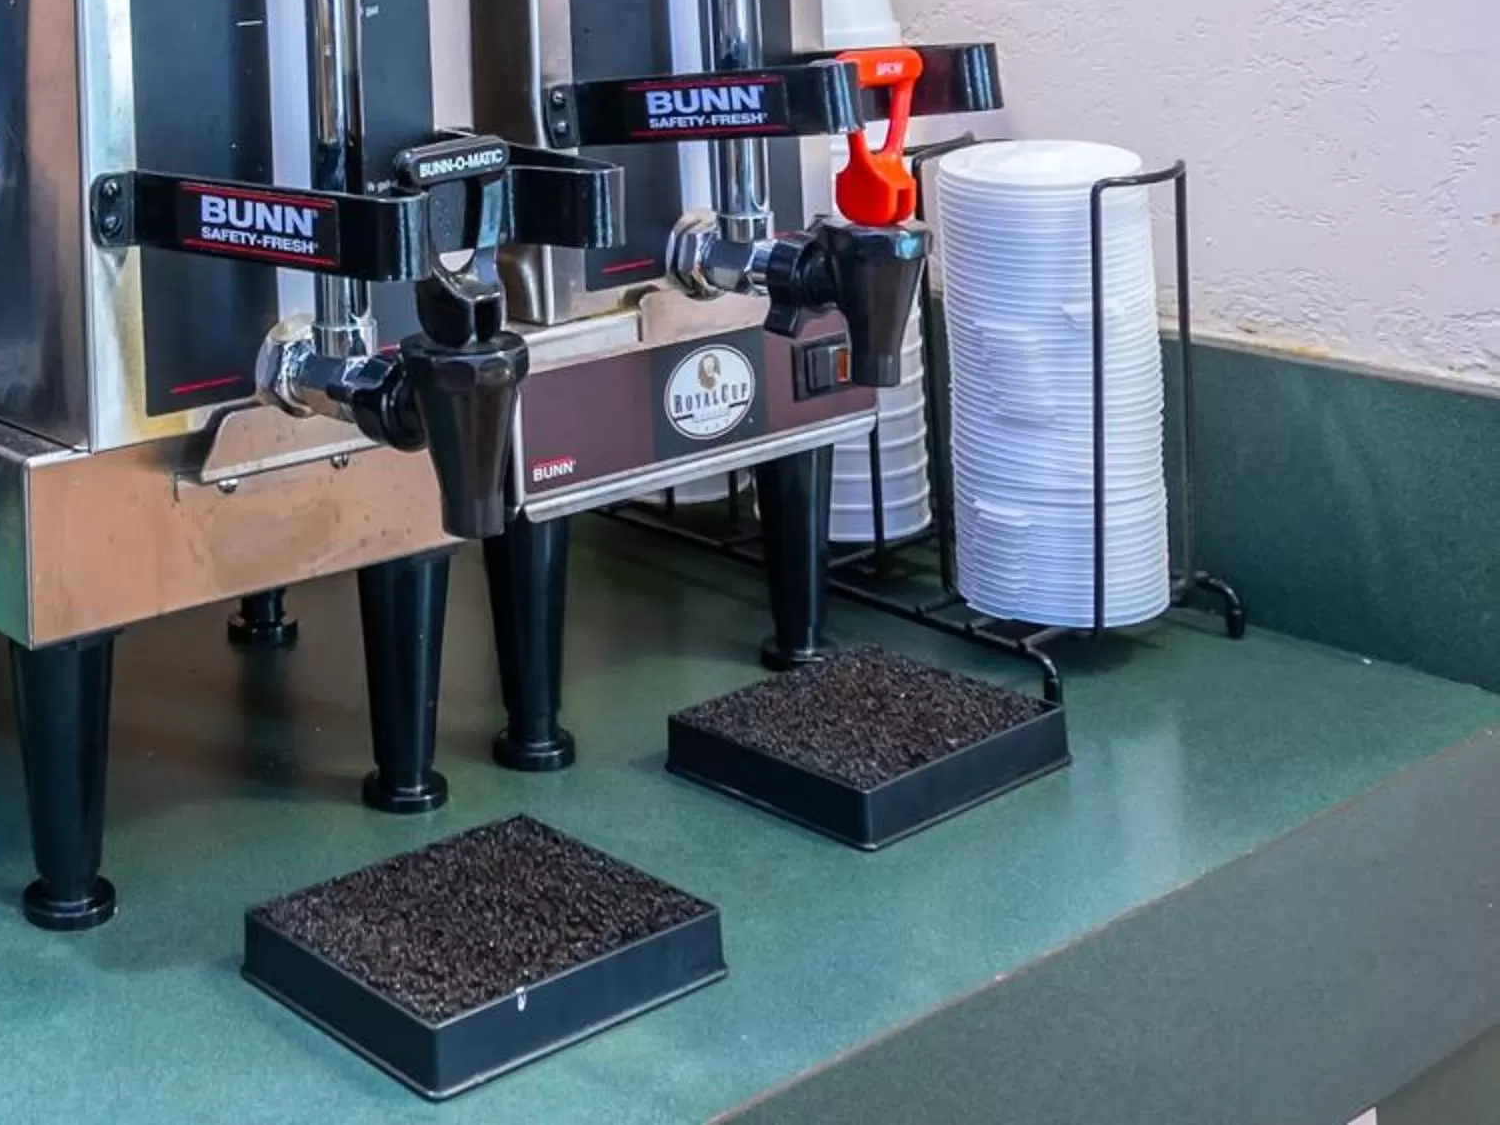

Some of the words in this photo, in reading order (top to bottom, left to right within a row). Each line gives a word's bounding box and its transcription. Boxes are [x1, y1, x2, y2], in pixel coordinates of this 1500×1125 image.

[645, 85, 761, 116] BUNN
[649, 113, 764, 129] SAFETY-FRESH
[419, 149, 504, 178] BUNN-O-MATIC
[201, 194, 314, 237] BUNN
[201, 226, 315, 255] SAFETY-FRESH
[533, 461, 573, 482] BUNN
